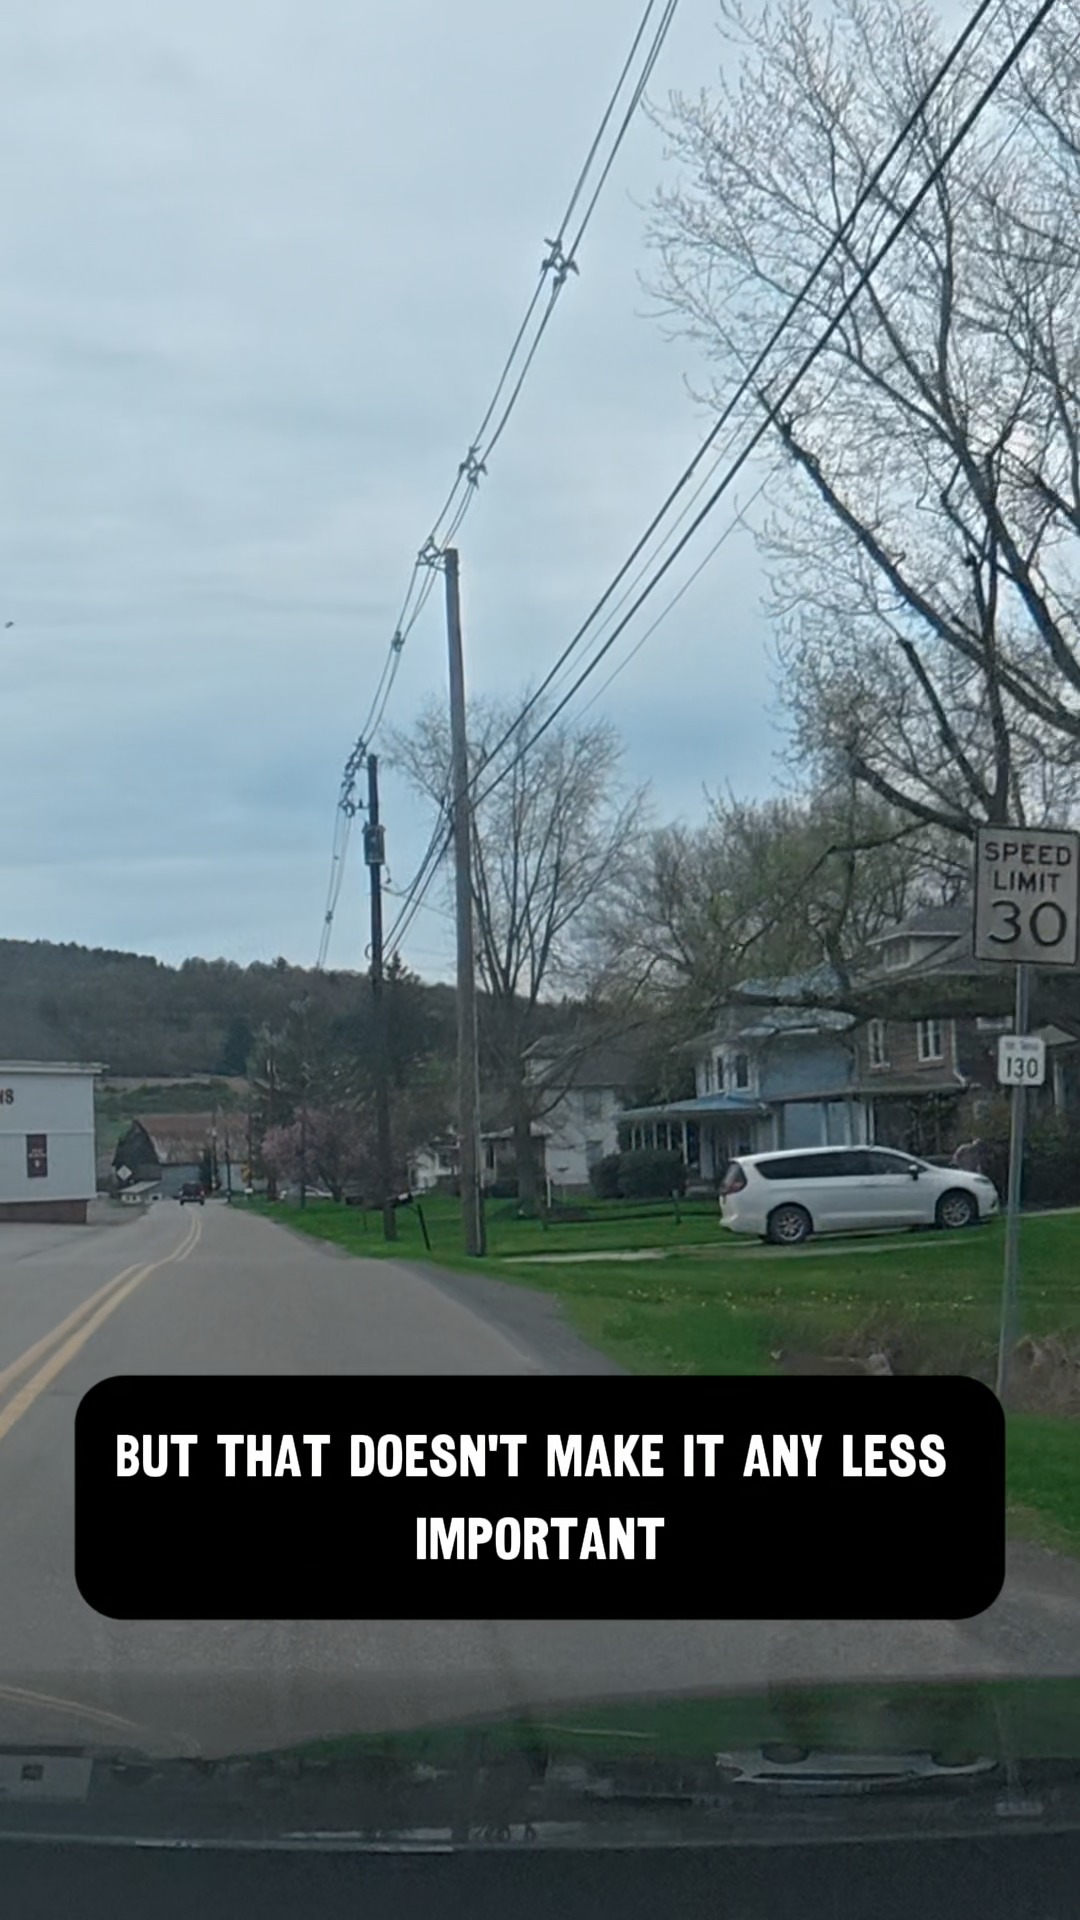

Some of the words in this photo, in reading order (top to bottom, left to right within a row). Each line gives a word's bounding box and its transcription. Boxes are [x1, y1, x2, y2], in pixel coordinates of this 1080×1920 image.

[985, 842, 1072, 867] SPEED
[994, 870, 1060, 893] LIMIT
[989, 901, 1067, 947] 30
[1007, 1056, 1039, 1080] 130
